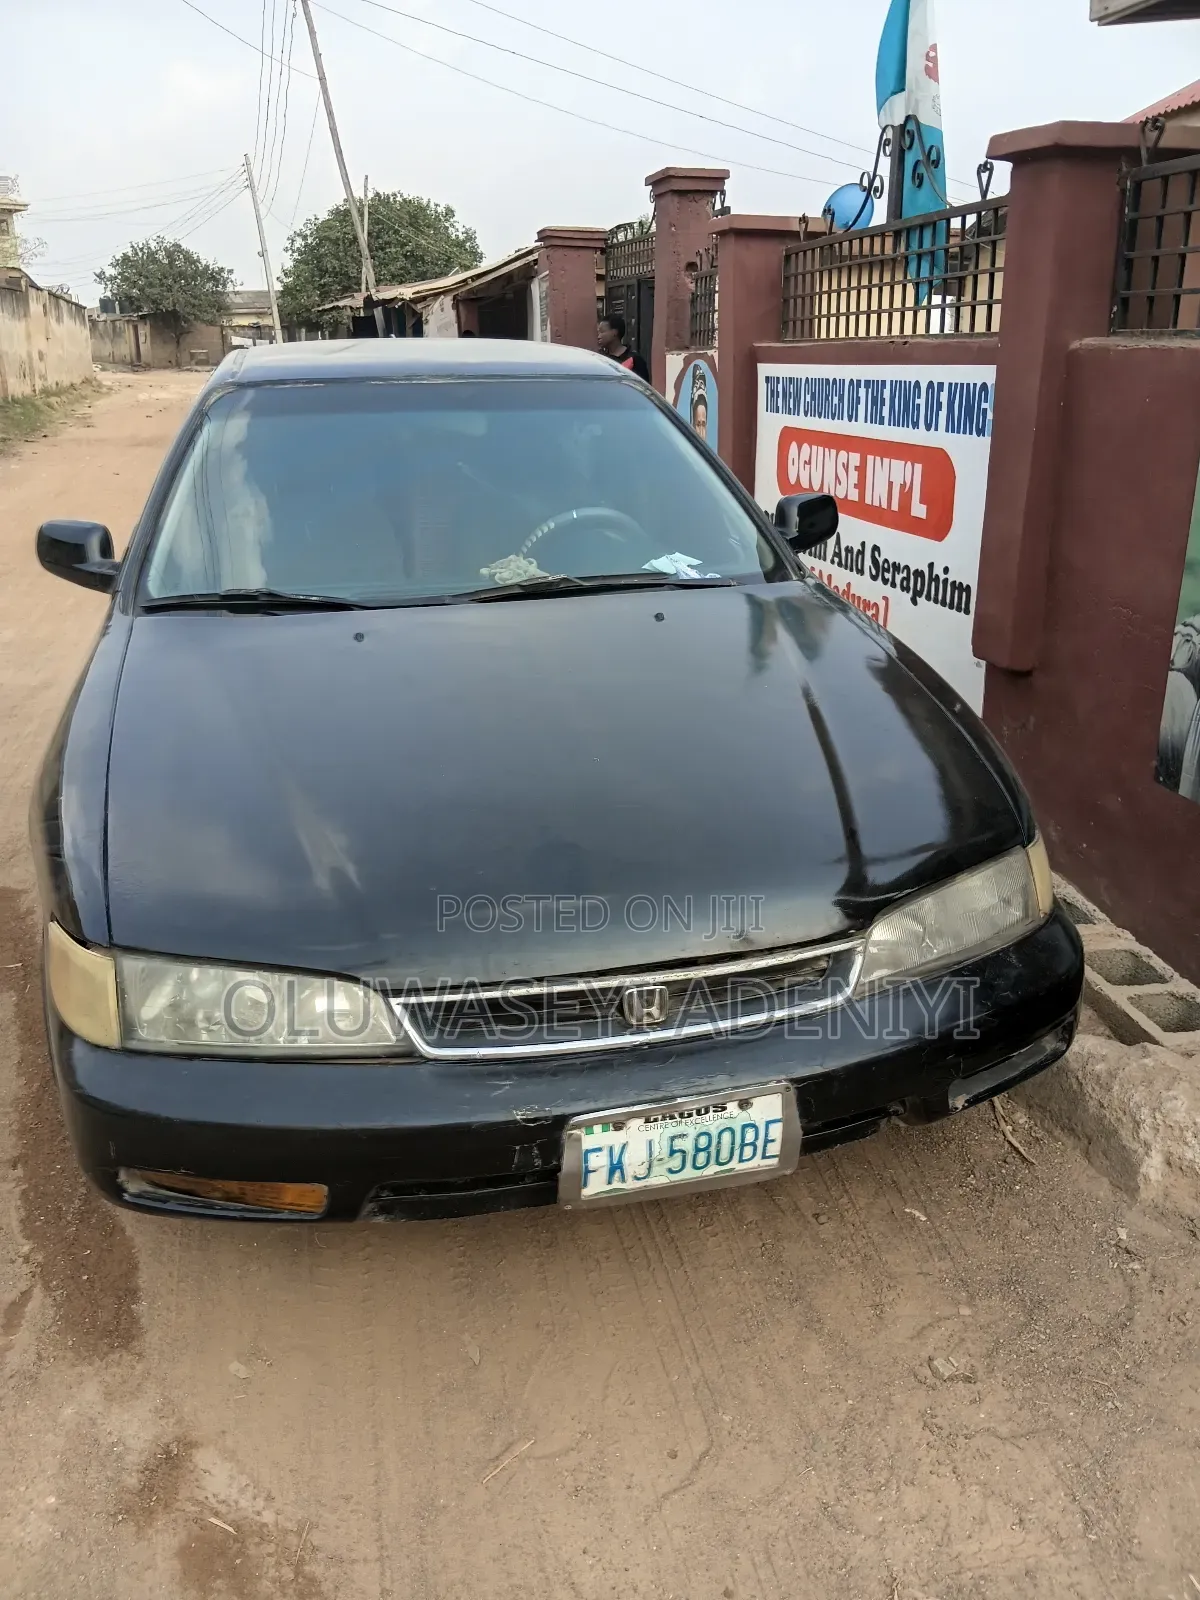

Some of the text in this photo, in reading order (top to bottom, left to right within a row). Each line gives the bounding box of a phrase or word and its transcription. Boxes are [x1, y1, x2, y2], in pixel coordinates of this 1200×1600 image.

[765, 375, 780, 414] THE
[781, 376, 802, 417] NEW
[803, 376, 846, 421] CHURCH
[847, 378, 862, 423] OF
[863, 379, 887, 426] THE
[888, 379, 922, 430] KING
[924, 380, 945, 432] OF
[787, 440, 927, 519] OGUNSE INT'L
[830, 531, 866, 577] And
[868, 543, 972, 616] Seraphim
[637, 1121, 670, 1132] CENTRE
[684, 1111, 735, 1126] EXCELLENCE
